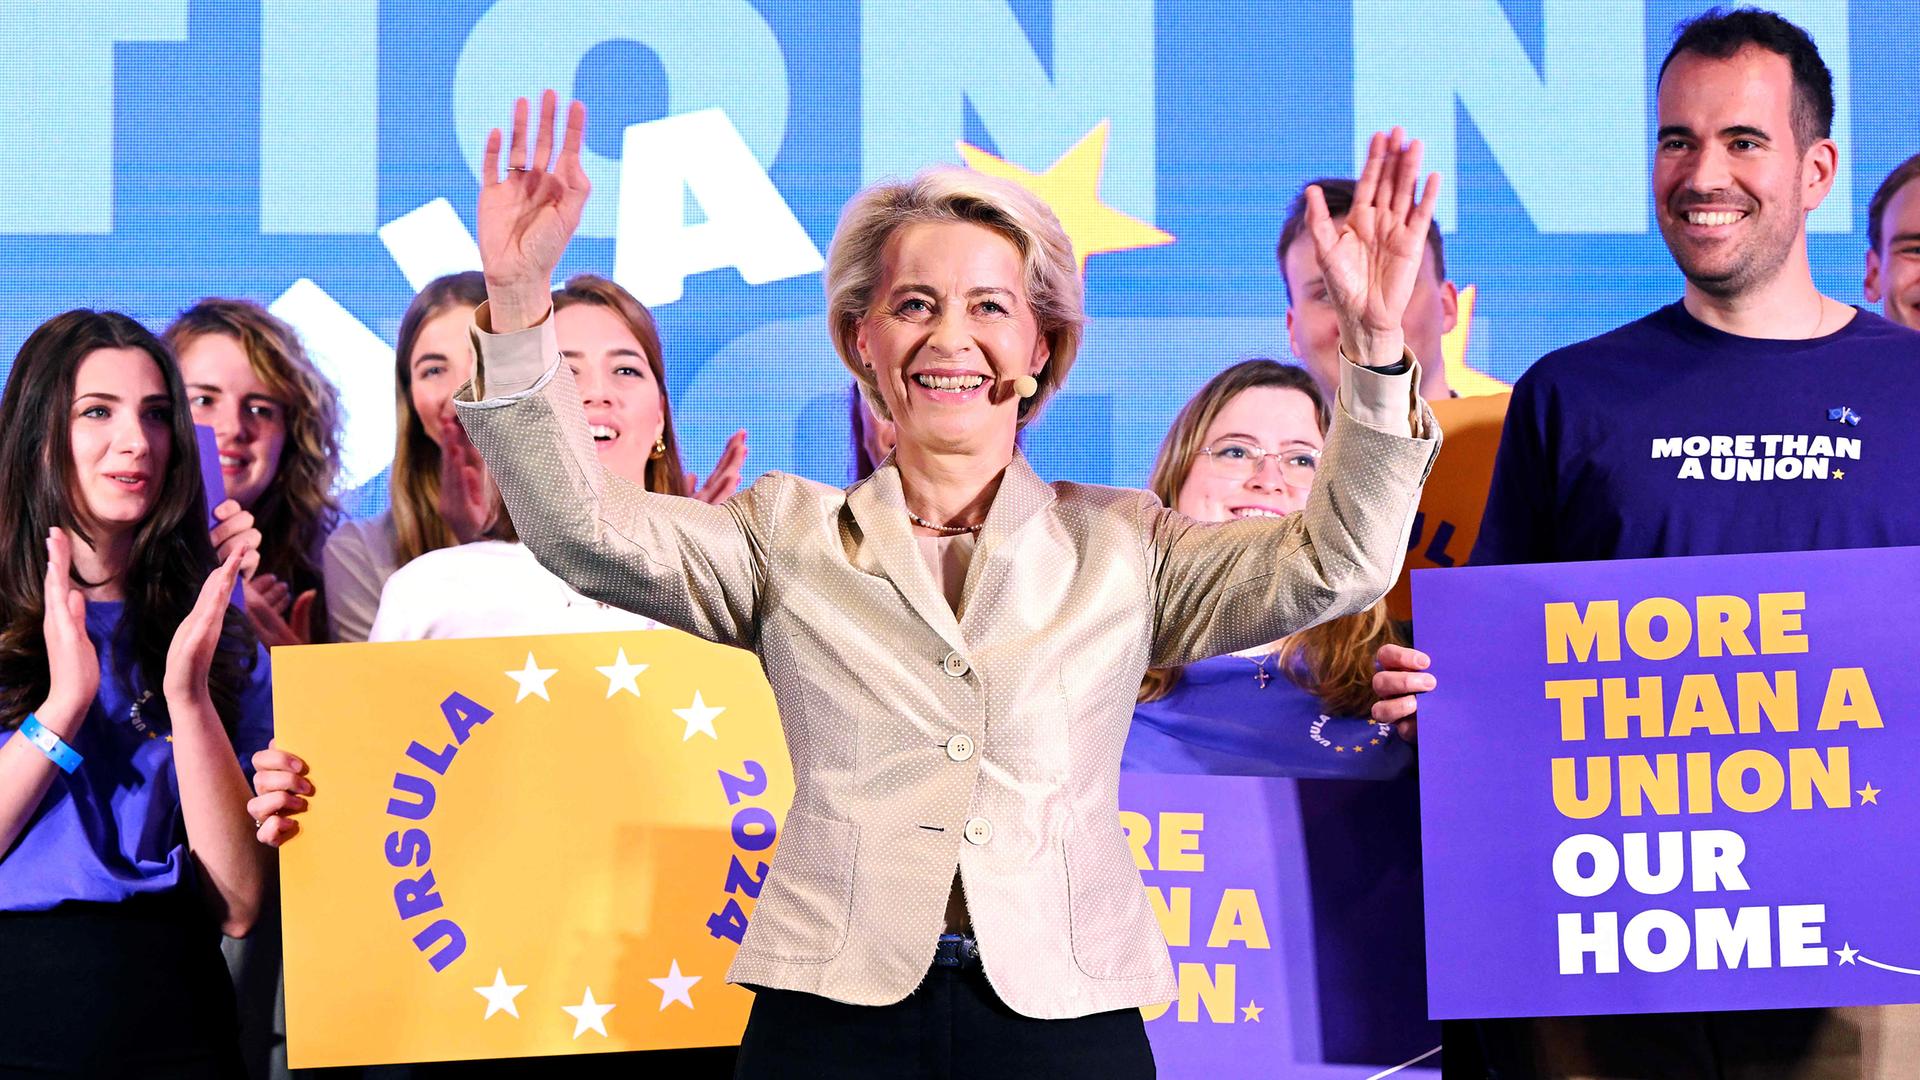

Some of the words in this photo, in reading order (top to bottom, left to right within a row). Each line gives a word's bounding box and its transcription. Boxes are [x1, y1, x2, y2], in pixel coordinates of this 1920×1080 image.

[1651, 435, 1756, 459] MORE
[1760, 434, 1862, 460] THAN
[1677, 457, 1705, 480] A
[1710, 456, 1830, 482] UNION
[1544, 591, 1810, 664] MORE
[1544, 670, 1800, 742] THAN
[1817, 667, 1884, 731] A
[1551, 746, 1851, 820] UNION
[384, 690, 494, 973] URSULA
[706, 759, 777, 946] 2024
[1118, 811, 1205, 872] RE
[1552, 829, 1751, 898] OUR
[1206, 888, 1271, 950] A
[1556, 903, 1830, 976] HOME
